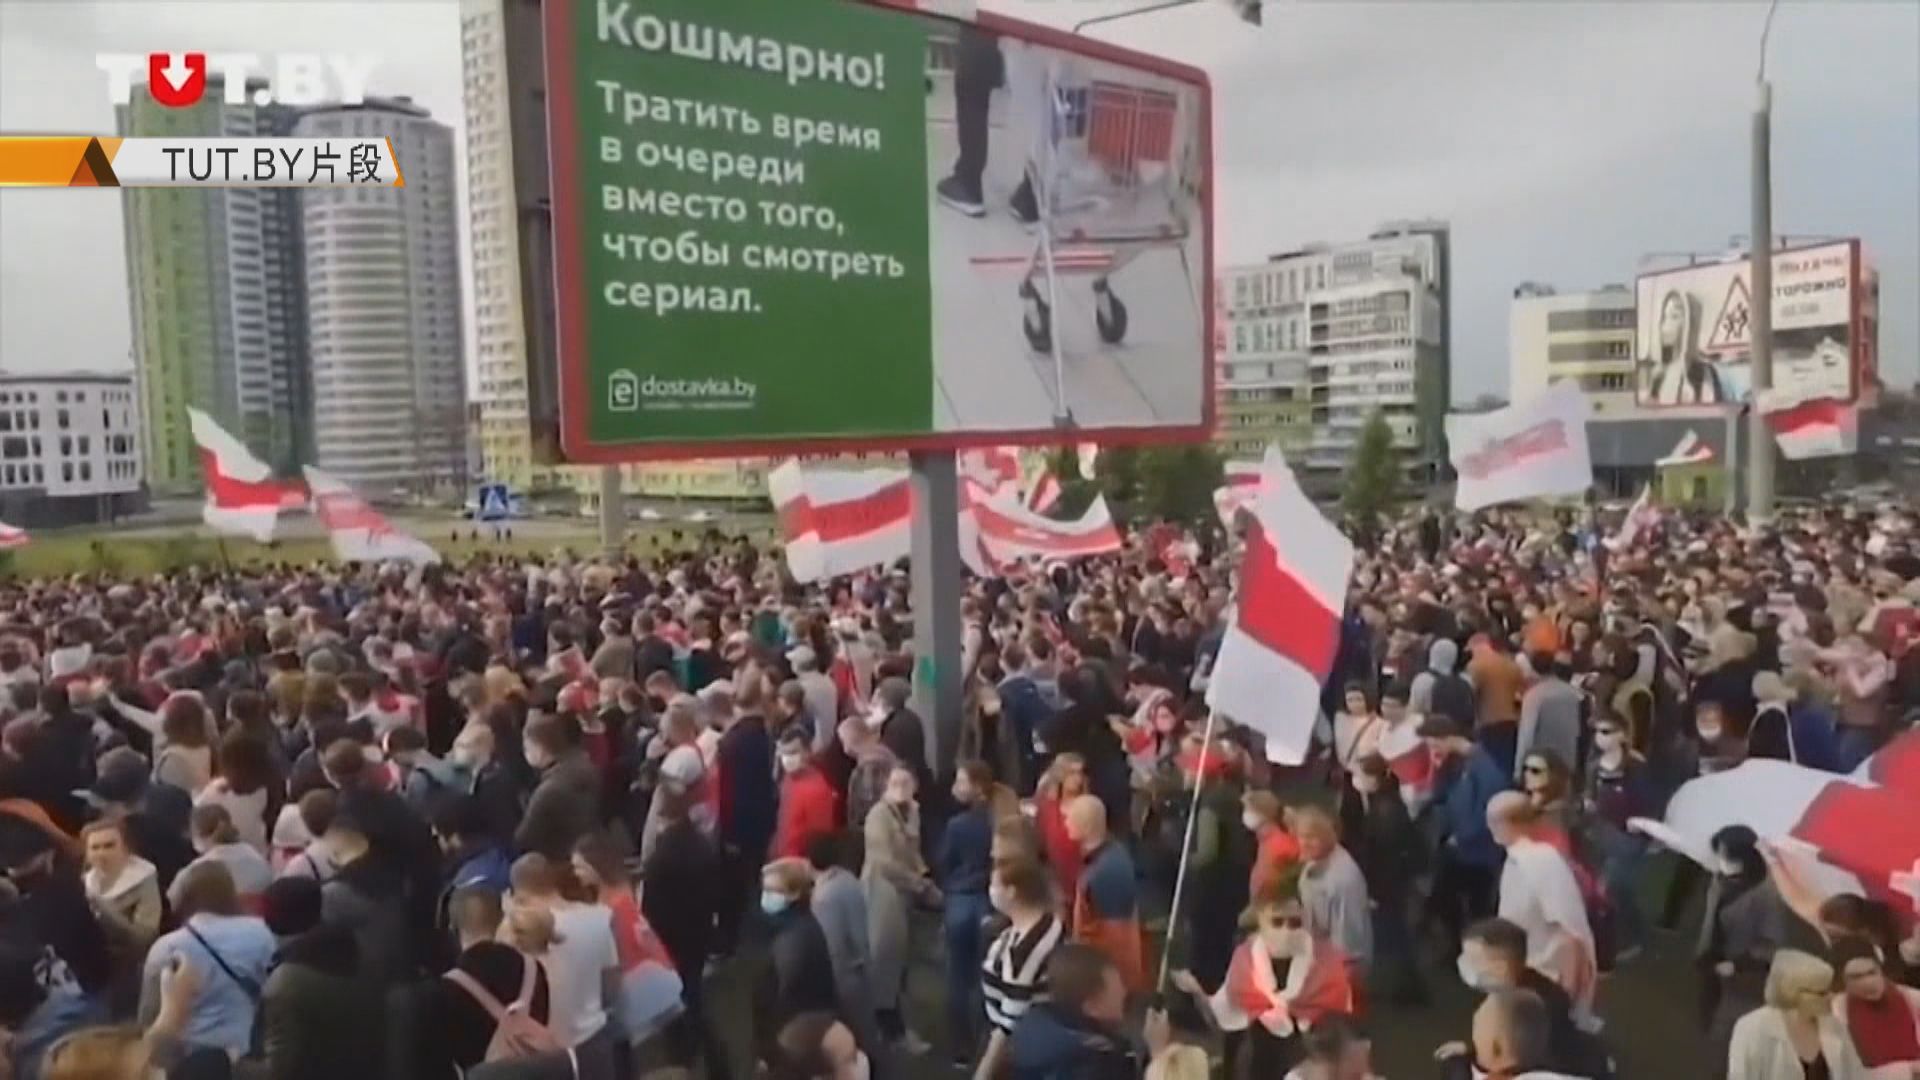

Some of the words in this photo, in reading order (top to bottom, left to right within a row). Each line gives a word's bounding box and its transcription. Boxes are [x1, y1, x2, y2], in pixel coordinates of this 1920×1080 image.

[596, 0, 885, 90] Кошмарно!
[596, 80, 762, 134] Тратить
[773, 113, 881, 152] время
[601, 136, 622, 163] в
[636, 142, 805, 185] очереди
[602, 184, 748, 223] вместо
[758, 200, 845, 237] того,
[602, 230, 729, 266] чтобы
[742, 244, 905, 281] смотреть
[604, 280, 763, 316] сериал.
[1776, 275, 1847, 297] ТОРОЖНО
[641, 374, 757, 399] dostavka.by
